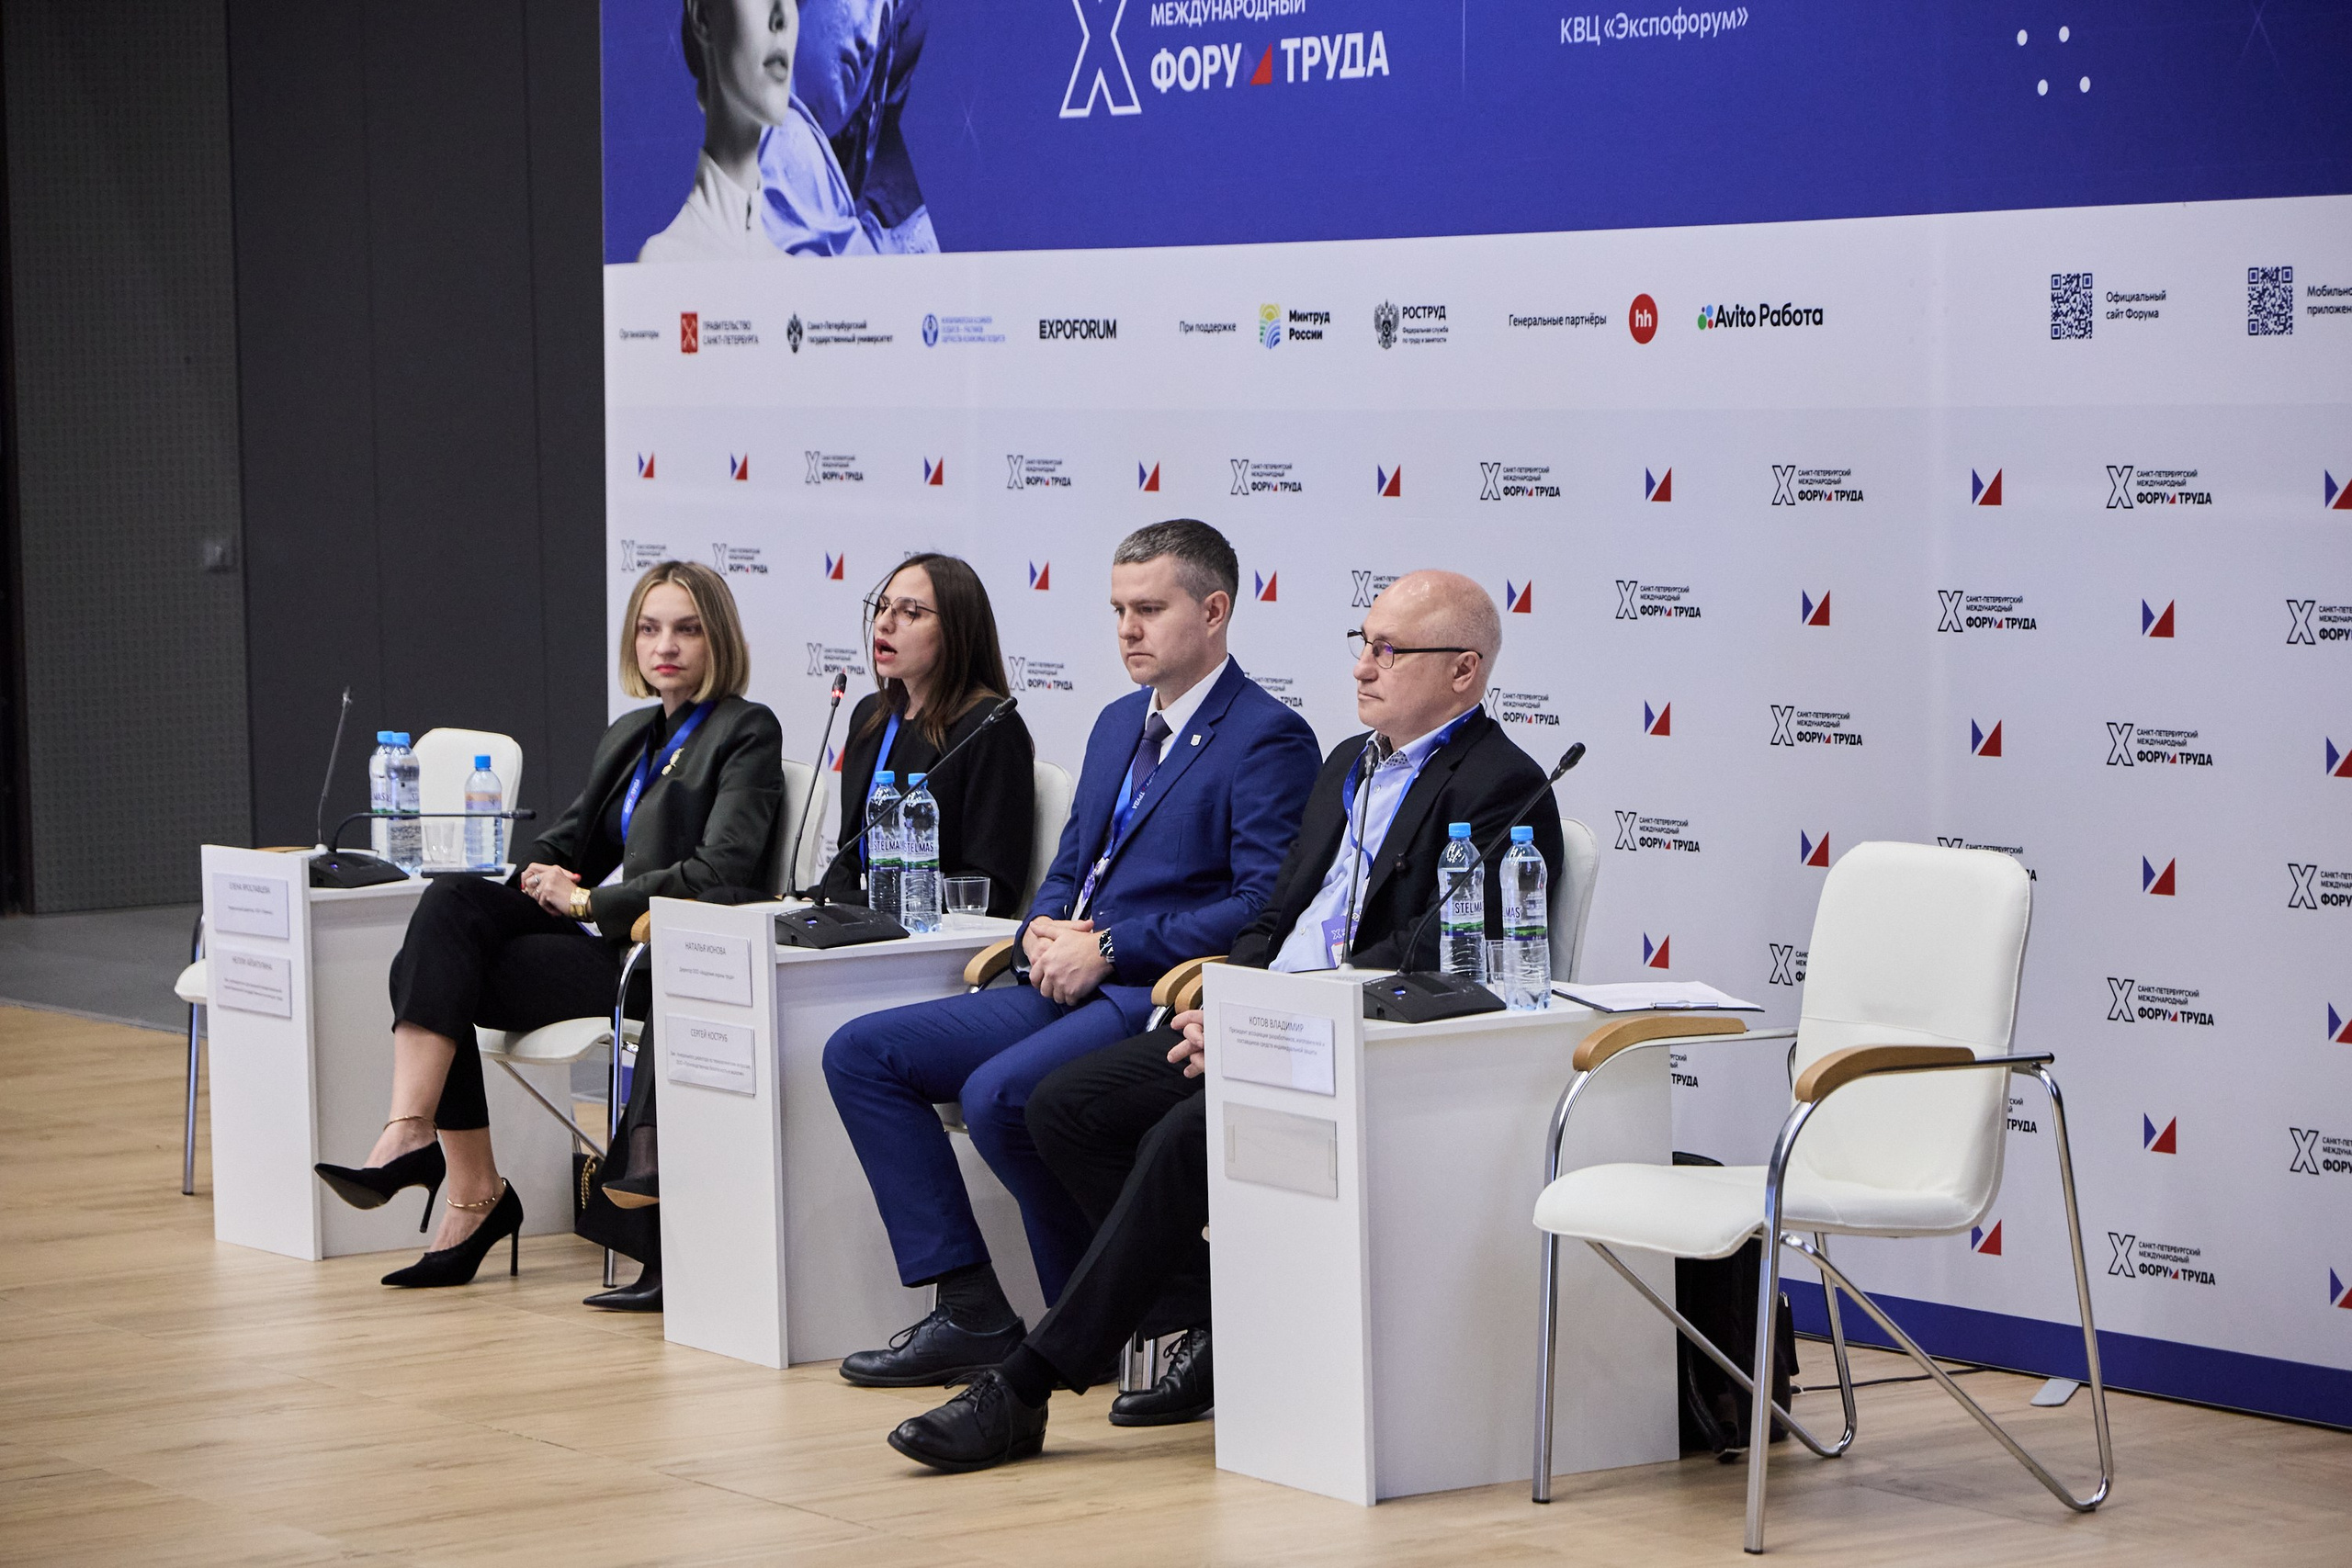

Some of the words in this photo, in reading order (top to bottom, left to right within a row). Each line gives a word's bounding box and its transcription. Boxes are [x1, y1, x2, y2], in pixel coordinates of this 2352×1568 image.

[1561, 16, 1600, 46] КВЦ
[1604, 6, 1749, 40] «Экспофорум»
[1281, 30, 1390, 84] ТРУДА
[2106, 290, 2166, 304] Официальный
[1288, 310, 1330, 324] Минтруд
[1402, 305, 1446, 321] РОСТРУД
[1634, 309, 1652, 328] hh
[1714, 304, 1756, 329] Avito
[1759, 302, 1824, 327] Работа
[2106, 309, 2124, 320] сайт
[2125, 308, 2159, 321] Форума
[1509, 314, 1564, 329] Генеральные
[1565, 312, 1607, 329] партнёры
[1039, 319, 1117, 339] EXPOFORUM
[1179, 321, 1194, 333] При
[1194, 322, 1237, 334] поддержке
[1288, 327, 1323, 341] России
[1279, 482, 1302, 491] ТРУДА
[1534, 487, 1560, 497] ТРУДА
[1835, 491, 1863, 501] ТРУДА
[2178, 492, 2212, 504] ТРУДА
[1674, 606, 1701, 617] ТРУДА
[2005, 617, 2036, 629] ТРУДА
[2319, 627, 2352, 640] ФОРУ
[1534, 714, 1559, 725] ТРУДА
[1833, 733, 1862, 745] ТРУДА
[2178, 752, 2212, 765] ТРУДА
[874, 840, 900, 851] STELMA
[904, 842, 933, 852] STELMAS
[1672, 840, 1700, 852] ТРУДА
[1454, 902, 1483, 914] STELMA
[1249, 1016, 1268, 1028] КОТОВ
[1269, 1019, 1305, 1032] ВЛАДИМИР
[2180, 1011, 2214, 1025] ТРУДА
[1671, 1073, 1699, 1088] ТРУДА
[2181, 1269, 2215, 1285] ТРУДА
